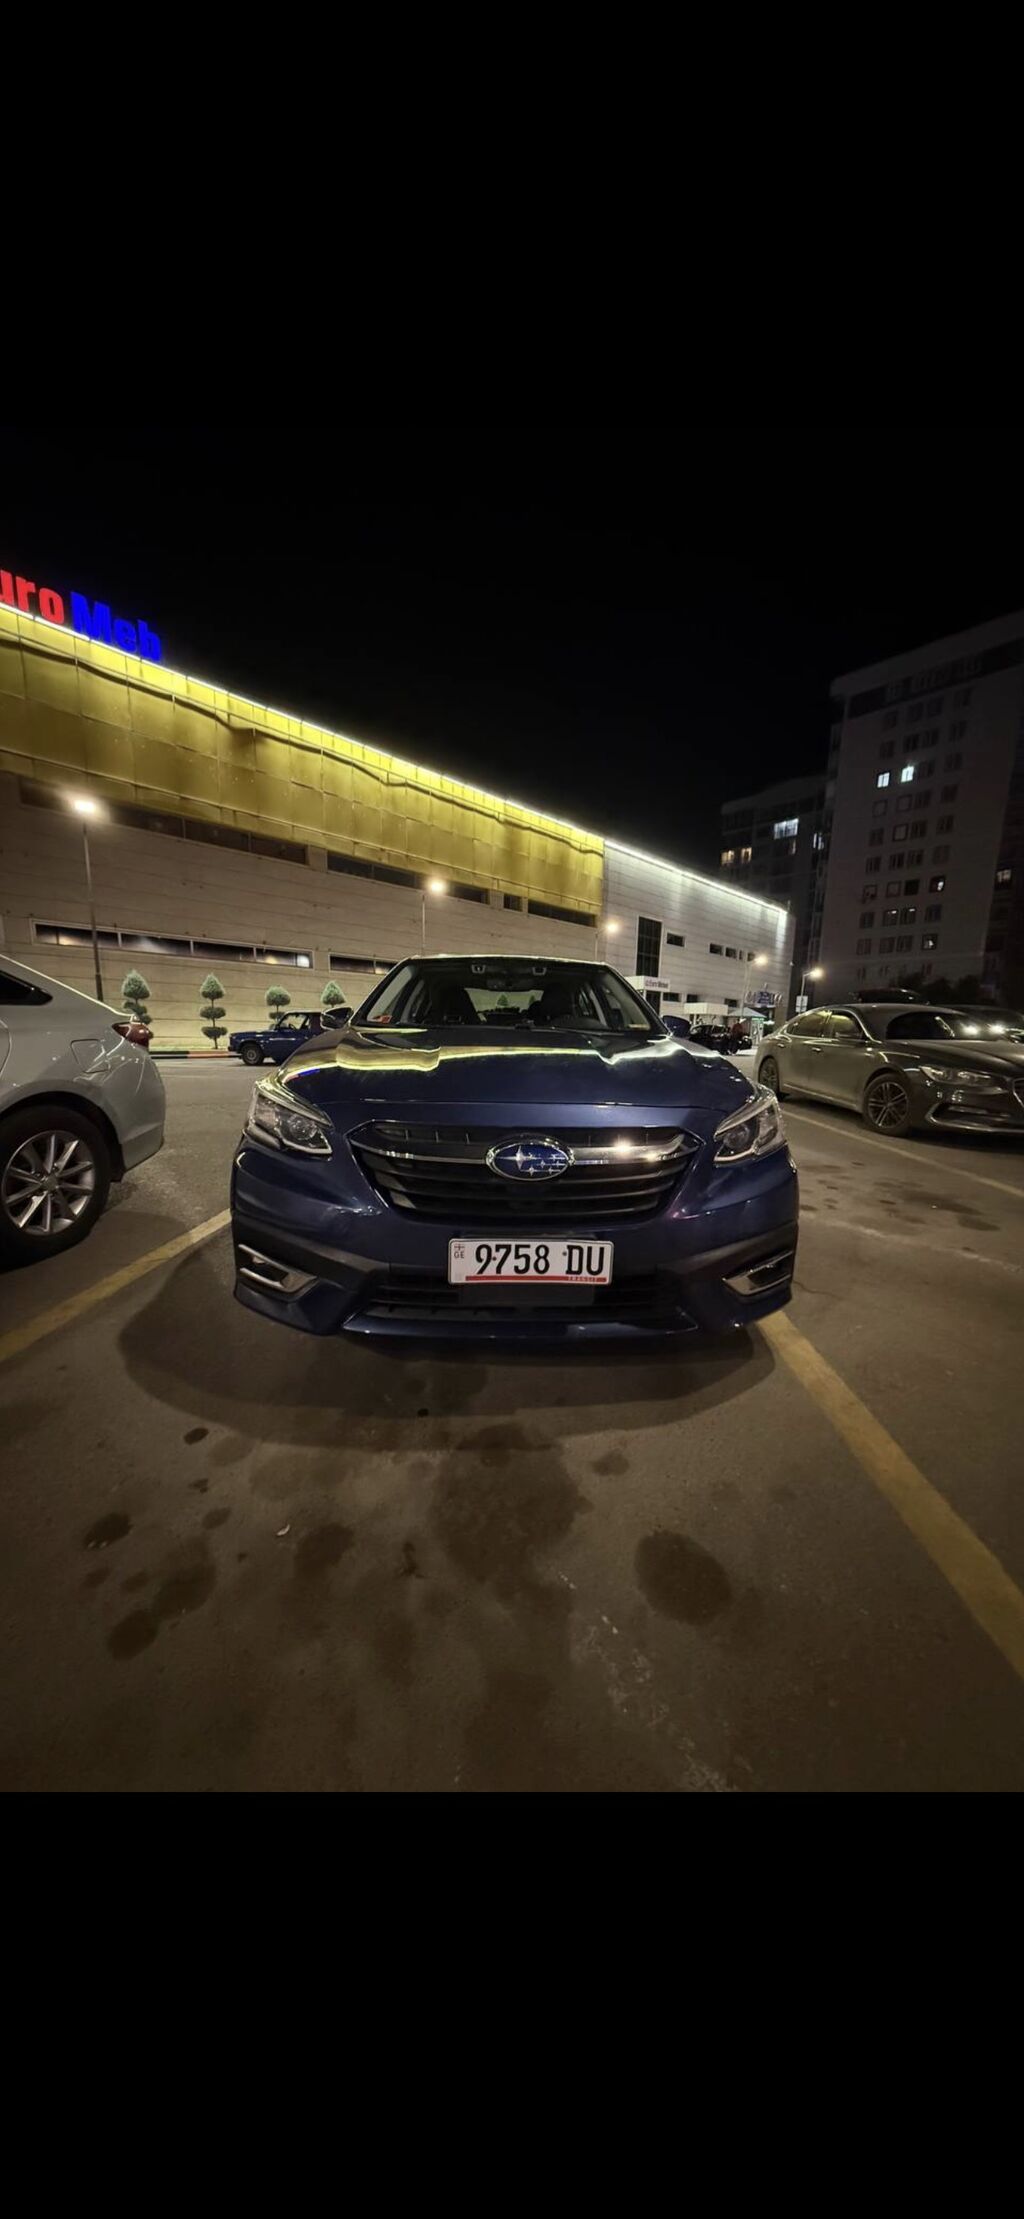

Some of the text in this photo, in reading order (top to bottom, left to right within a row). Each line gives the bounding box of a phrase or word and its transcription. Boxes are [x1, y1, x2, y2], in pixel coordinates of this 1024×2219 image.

[71, 591, 161, 661] Meb
[454, 1251, 465, 1259] GE
[475, 1244, 605, 1276] 9758 DU
